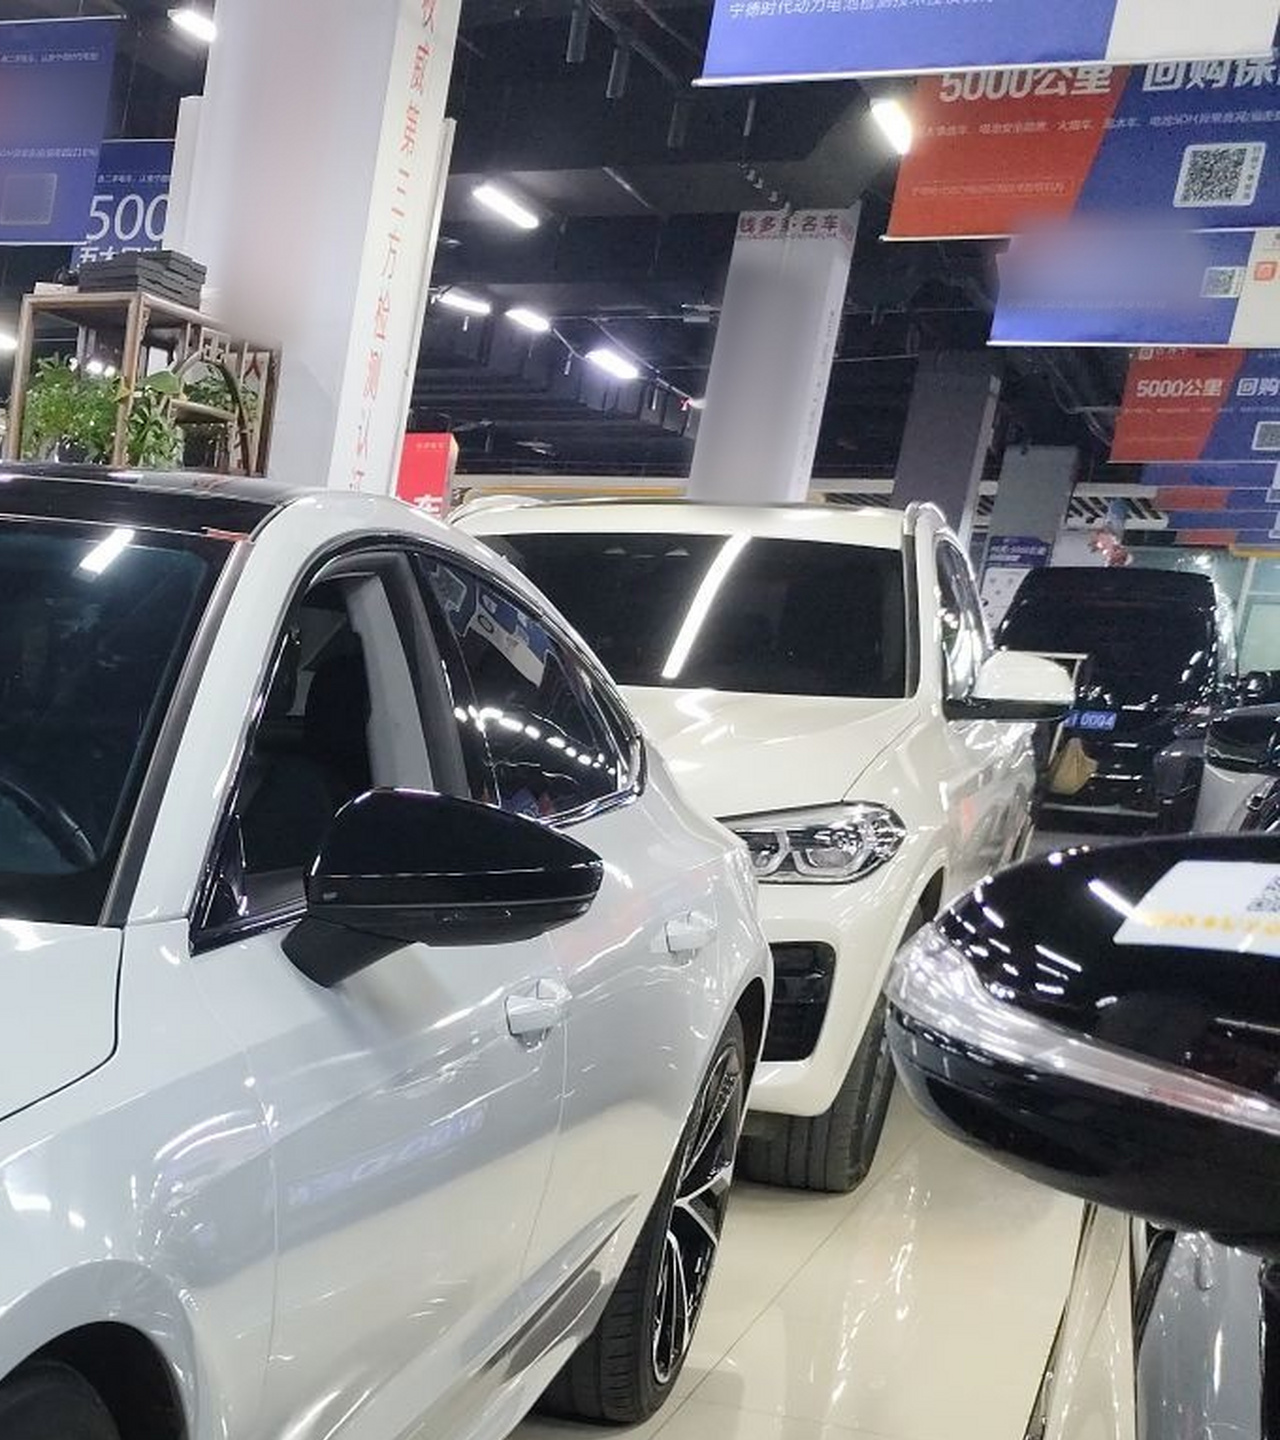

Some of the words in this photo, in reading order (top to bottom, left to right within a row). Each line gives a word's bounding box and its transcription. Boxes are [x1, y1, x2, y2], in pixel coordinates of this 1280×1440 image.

[940, 66, 1114, 102] 5000公里
[1143, 59, 1280, 92] 回购保
[1135, 378, 1223, 397] 5000公里
